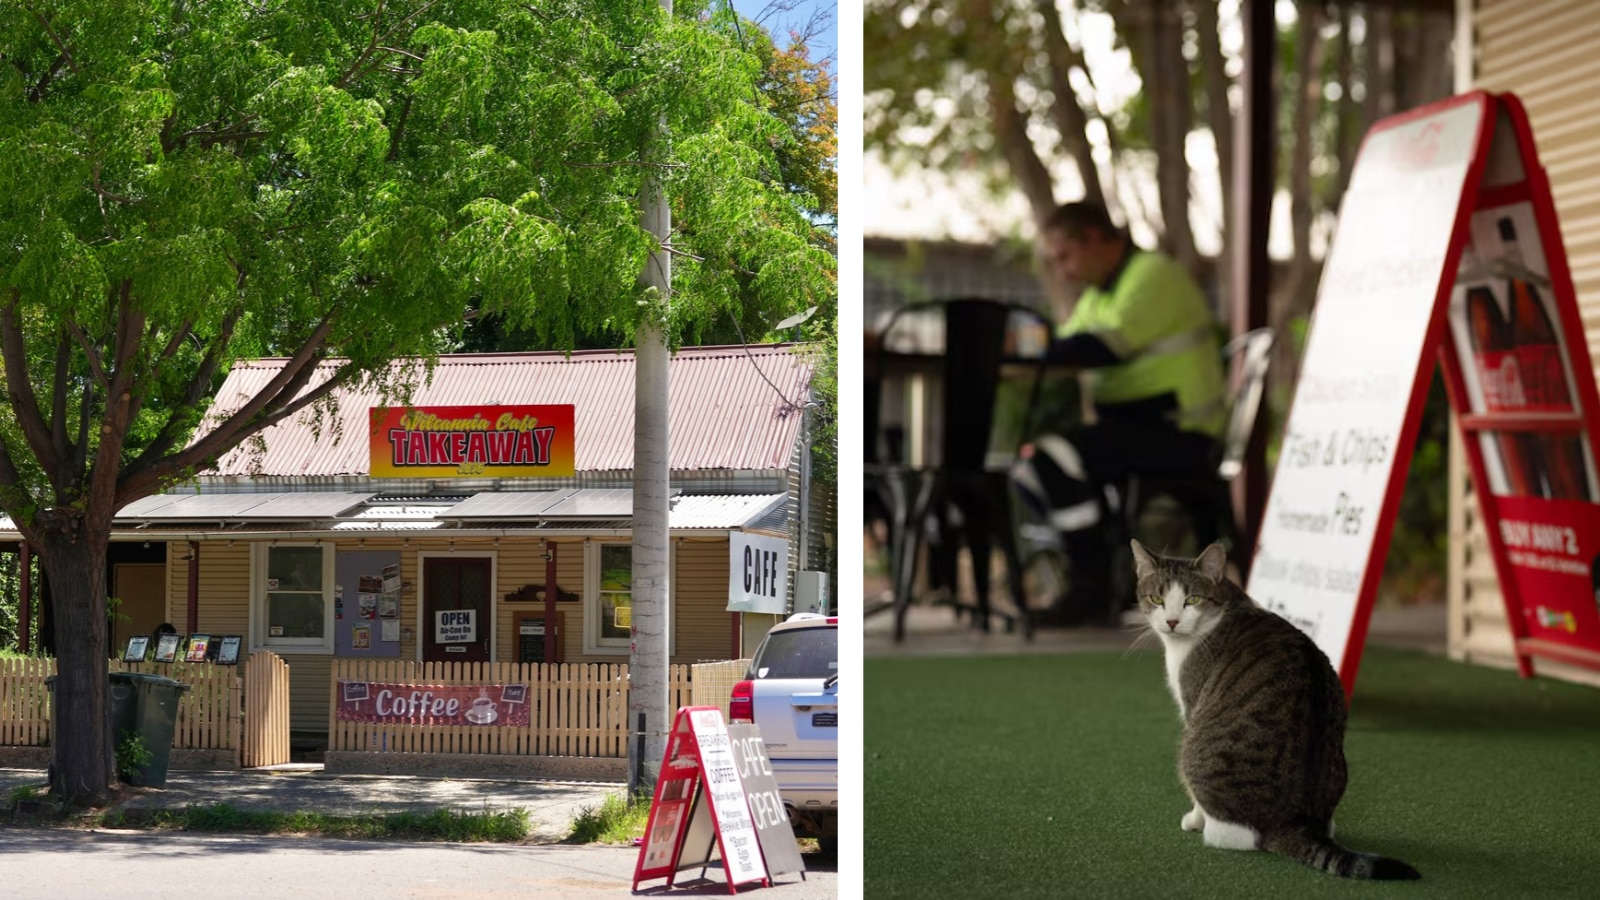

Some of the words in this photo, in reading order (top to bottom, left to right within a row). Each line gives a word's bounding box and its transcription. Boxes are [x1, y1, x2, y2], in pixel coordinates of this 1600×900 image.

[400, 411, 490, 431] Wilcannia
[496, 412, 538, 432] Cafe
[391, 428, 553, 465] TAKEAWAY
[1333, 491, 1364, 535] Pies
[1564, 526, 1580, 555] 2
[744, 544, 777, 598] CAFE
[441, 612, 470, 625] OPEN
[376, 689, 459, 719] Coffee
[732, 737, 772, 778] CAFE
[710, 767, 737, 784] COFFEE
[748, 789, 787, 831] OPEN
